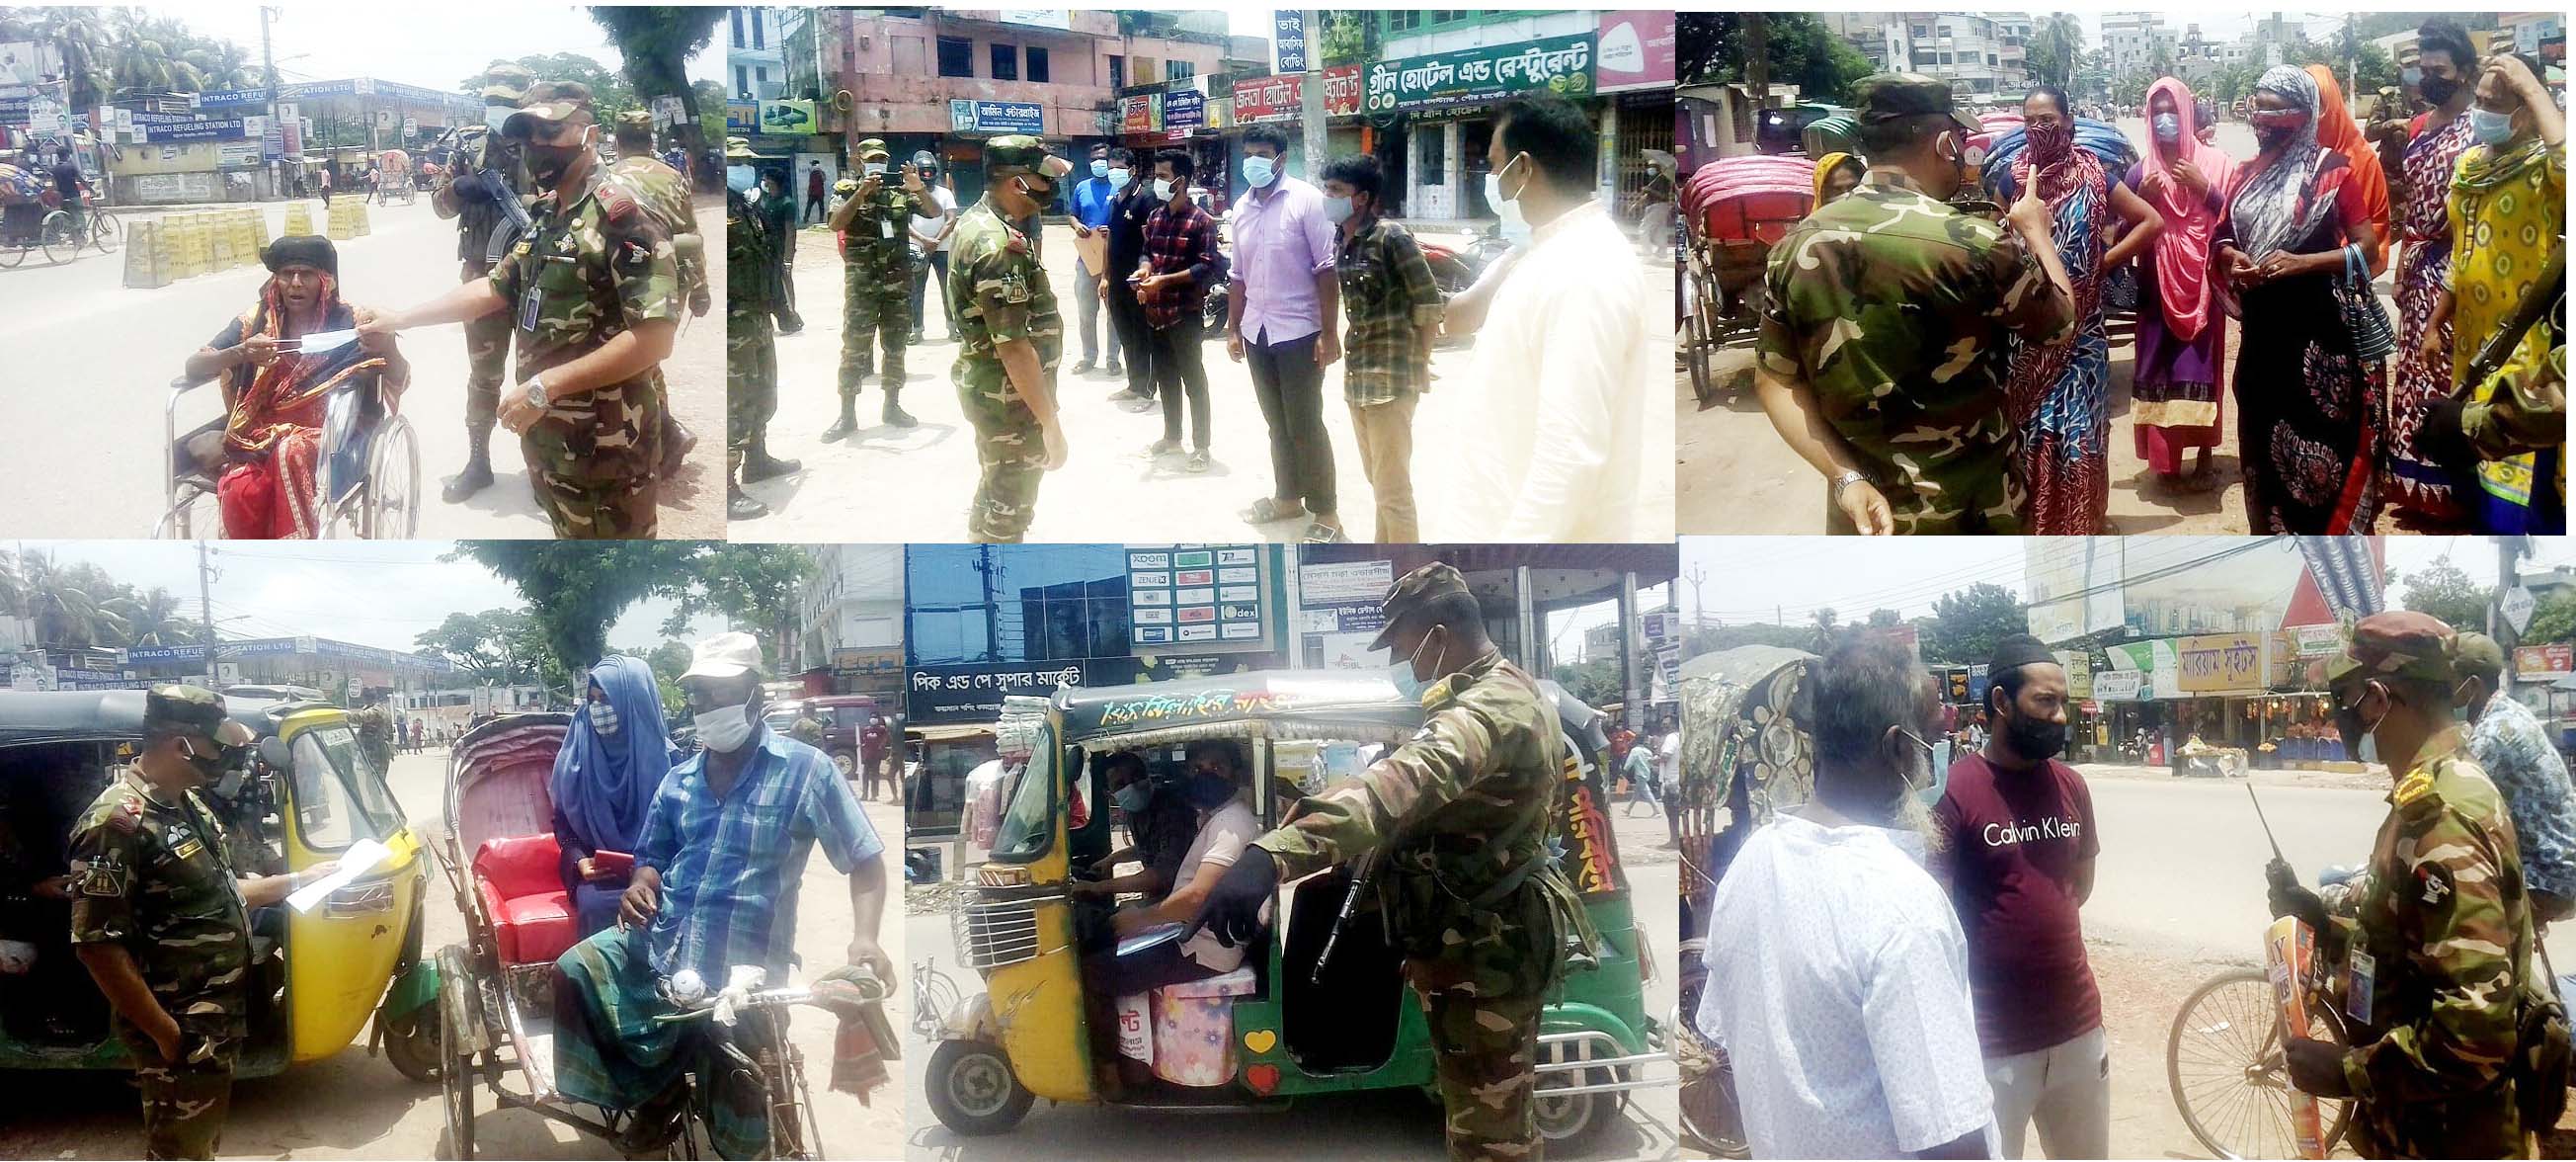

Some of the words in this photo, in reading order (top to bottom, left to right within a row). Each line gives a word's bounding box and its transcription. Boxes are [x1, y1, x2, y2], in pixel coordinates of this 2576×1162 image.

[1277, 17, 1302, 33] ভাই
[1368, 63, 1397, 96] গ্রীন
[1400, 61, 1454, 92] হোটেল
[201, 93, 238, 103] INTRACO
[1236, 88, 1260, 109] জনতা
[1263, 80, 1293, 106] হোটেল
[981, 104, 1003, 117] আমিন
[148, 124, 173, 133] INTRACO
[173, 122, 204, 132] REFUELING
[204, 121, 229, 130] STATION
[129, 649, 171, 659] INTRACO
[105, 680, 140, 690] REFUELING
[913, 671, 941, 692] পিক
[974, 673, 992, 689] পে
[995, 672, 1033, 693] সুপার
[1036, 665, 1081, 687] মার্কেট
[1983, 819, 2041, 847] Calvin
[2041, 815, 2081, 839] Klein
